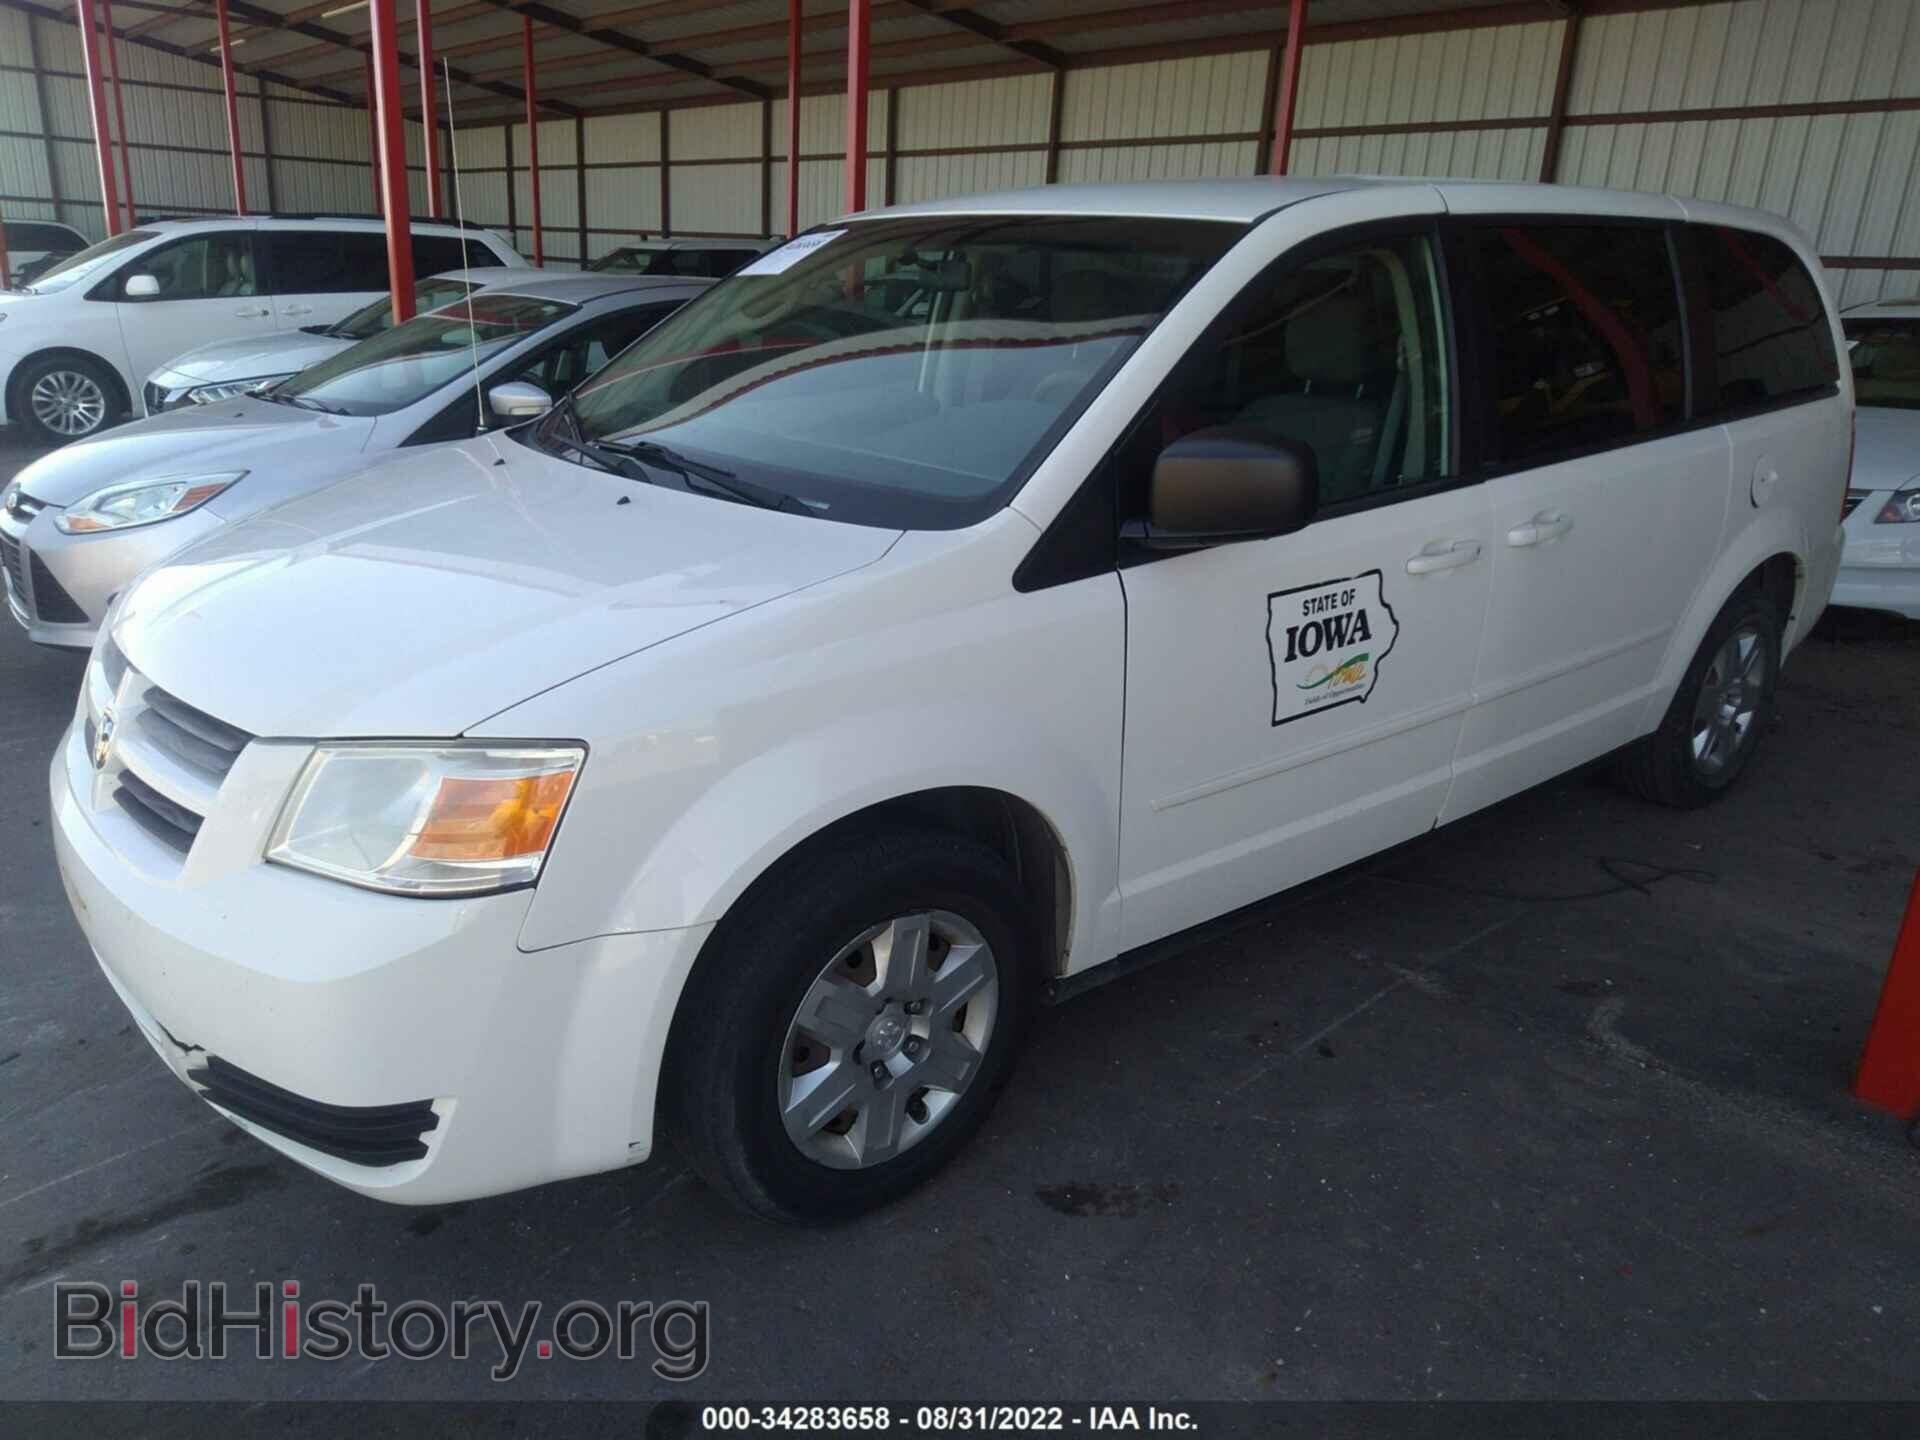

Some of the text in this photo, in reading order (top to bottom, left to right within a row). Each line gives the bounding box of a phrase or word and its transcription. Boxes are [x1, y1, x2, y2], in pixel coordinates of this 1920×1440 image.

[1302, 588, 1356, 616] STATE OF
[1284, 608, 1372, 662] IOWA
